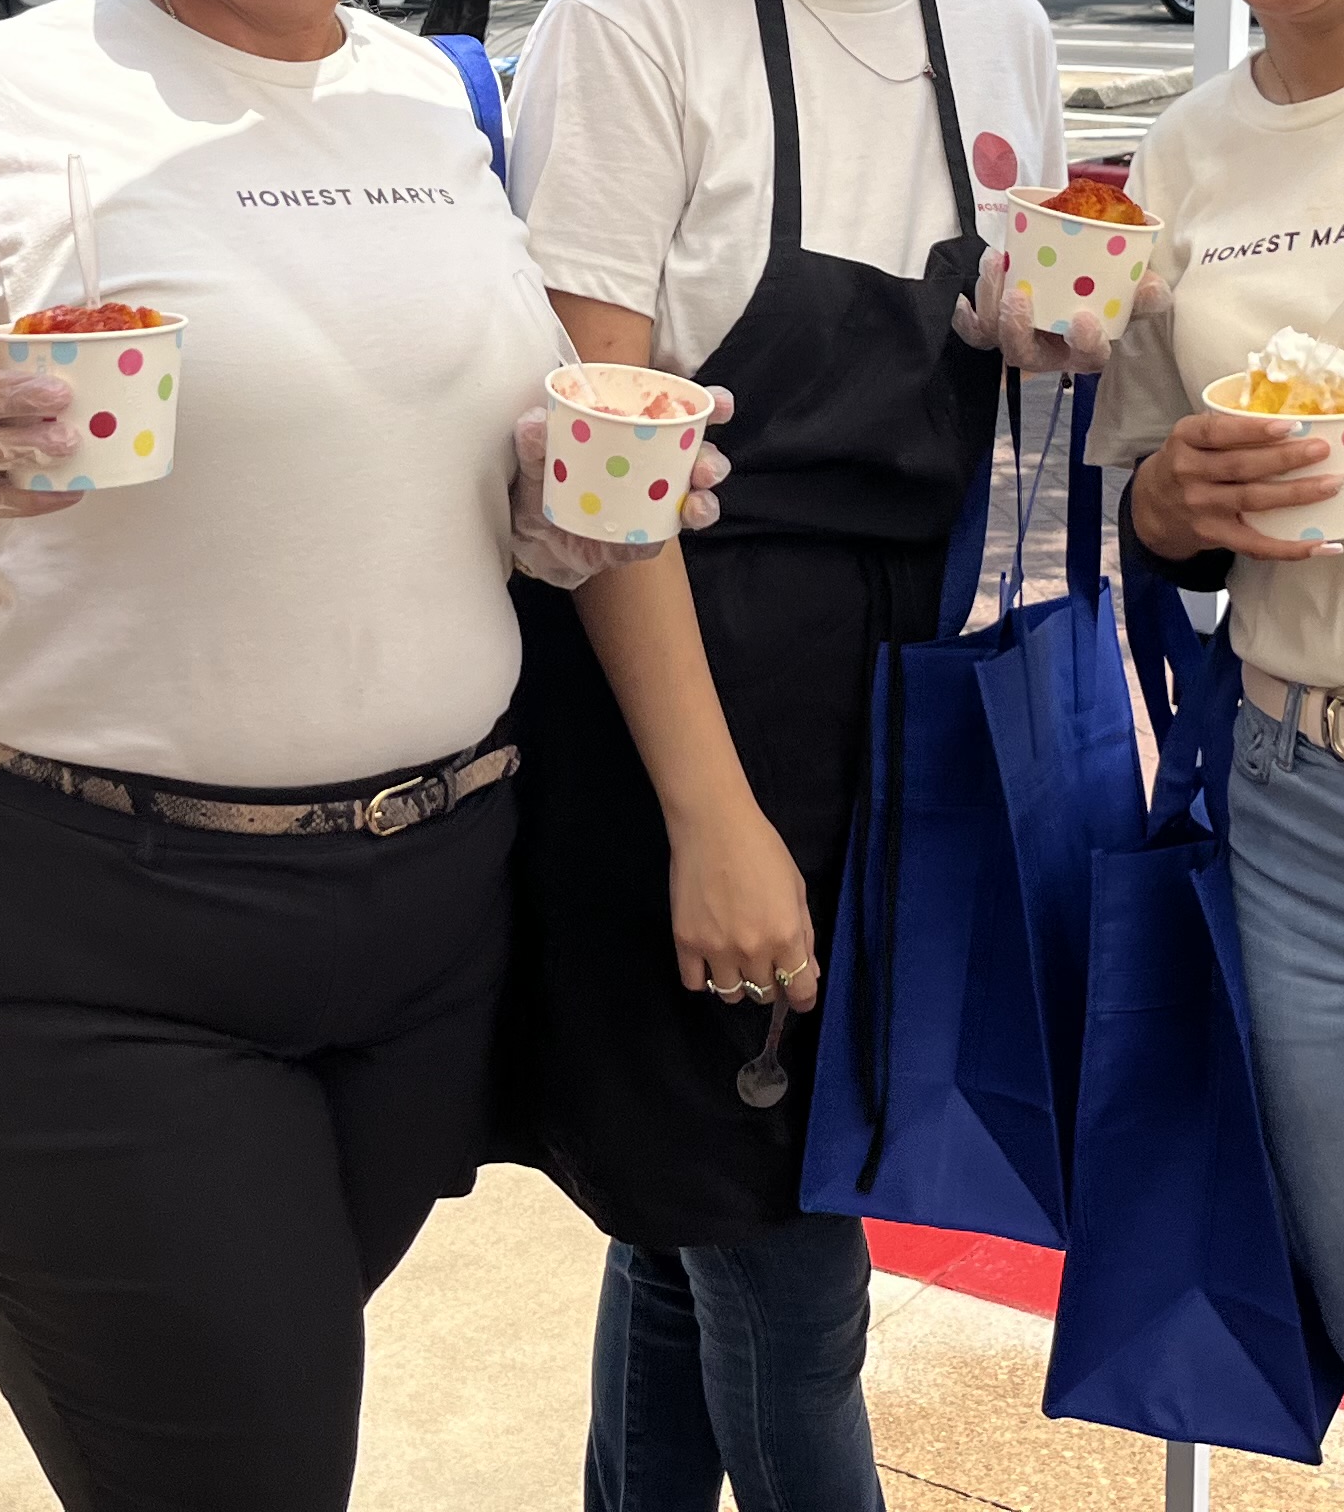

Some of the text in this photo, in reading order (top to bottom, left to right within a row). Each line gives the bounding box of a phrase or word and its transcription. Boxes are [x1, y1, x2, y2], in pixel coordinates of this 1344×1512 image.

[236, 187, 455, 208] HONEST MARY'S
[1200, 231, 1301, 266] HONEST
